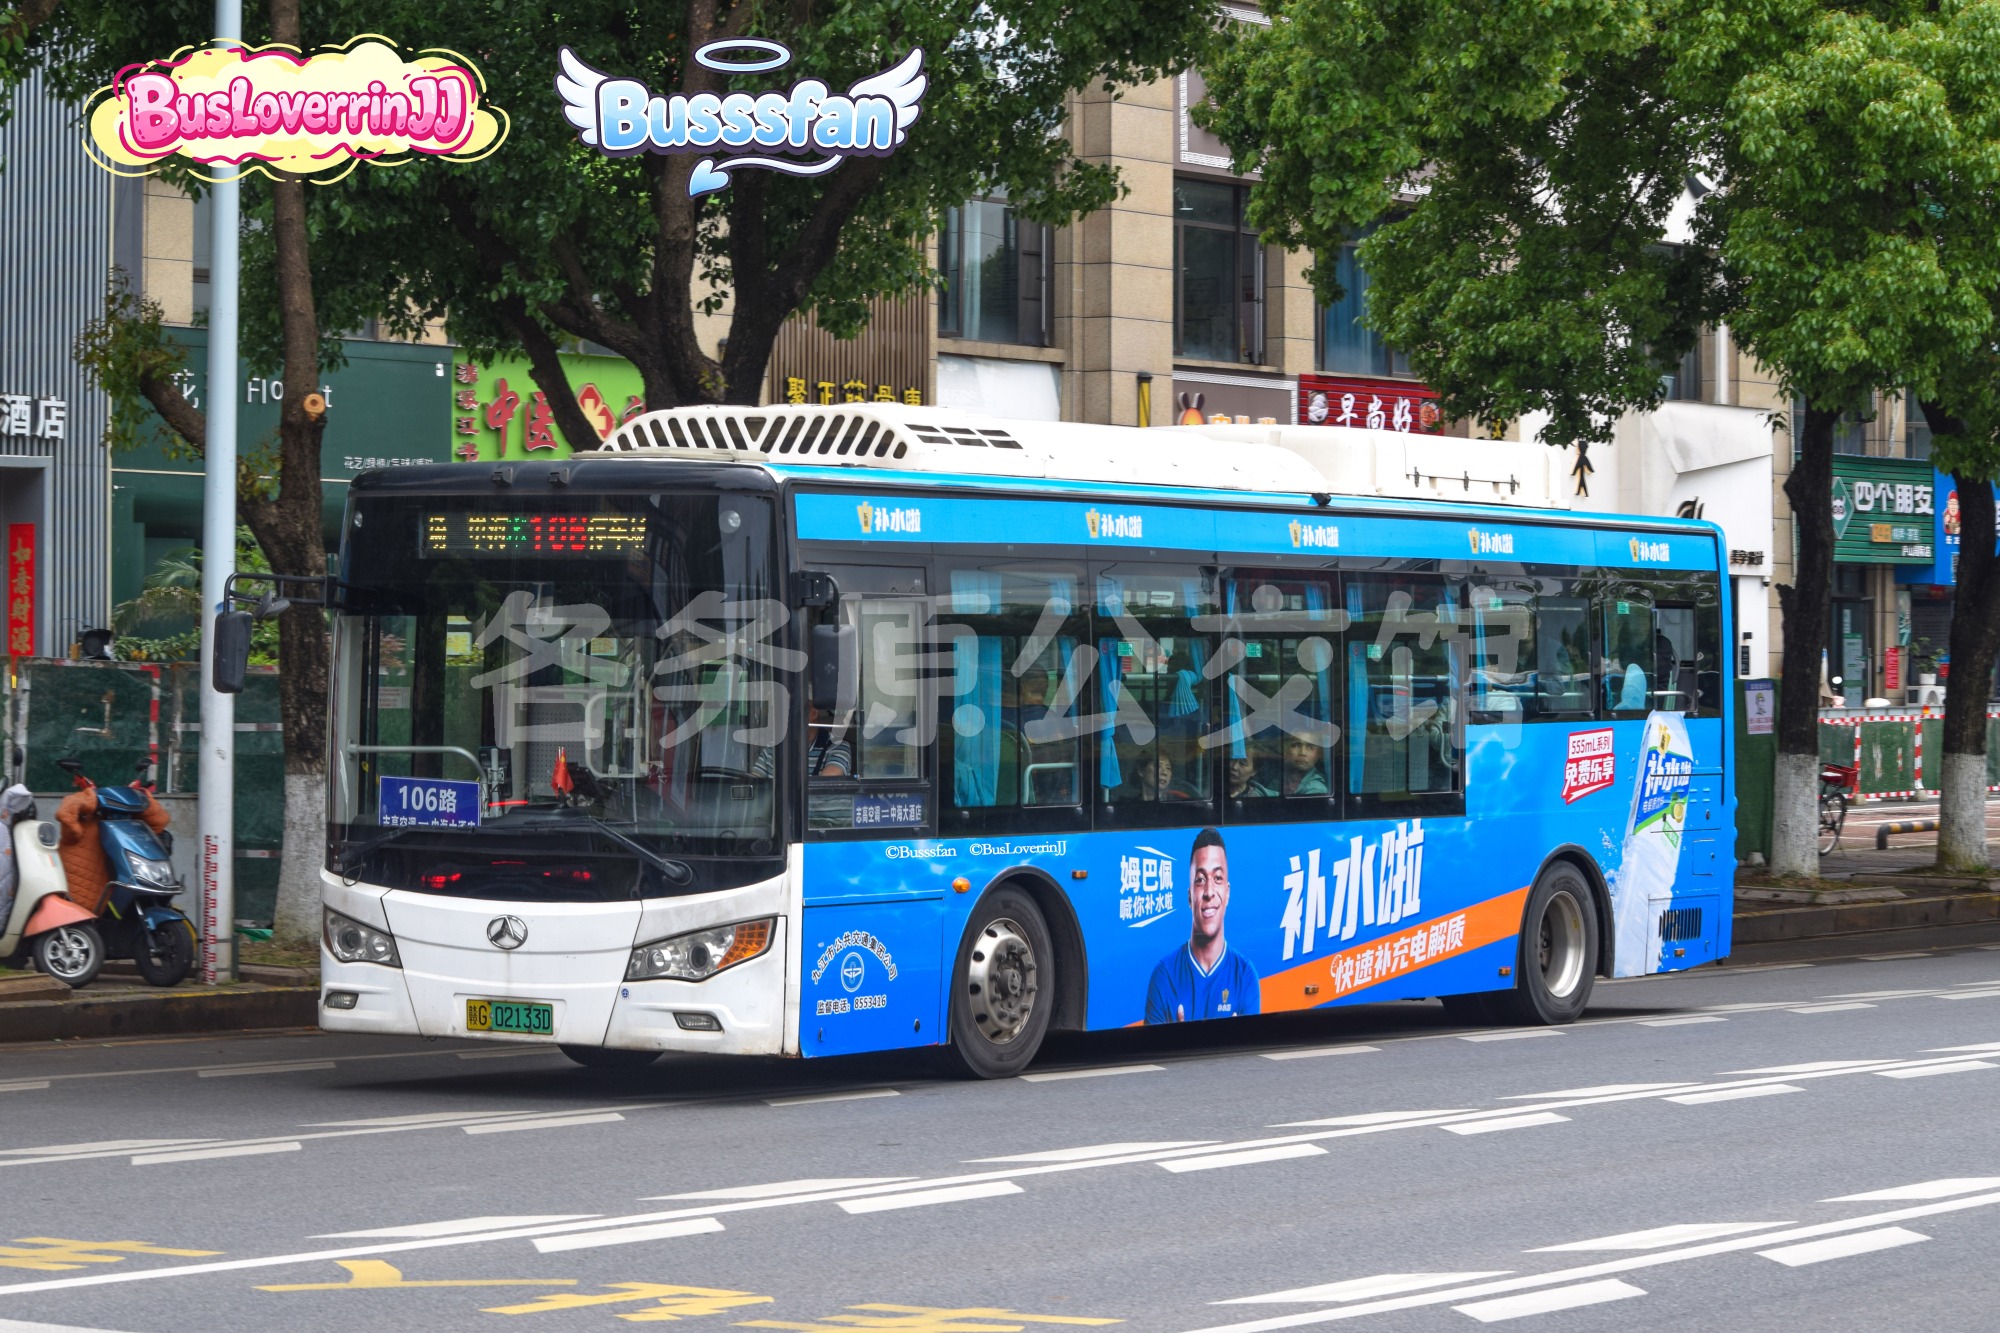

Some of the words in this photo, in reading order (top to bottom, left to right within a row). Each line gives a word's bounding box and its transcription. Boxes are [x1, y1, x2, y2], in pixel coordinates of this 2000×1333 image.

[1854, 481, 1934, 515] 四个朋友
[874, 507, 921, 533] 补水啦
[1101, 513, 1143, 539] 补水啦
[1302, 524, 1339, 548] 补水啦
[1481, 531, 1514, 554] 补水啦
[1640, 541, 1671, 563] 补水啦
[1562, 756, 1615, 796] 免费乐享
[1644, 753, 1692, 798] 补水啦
[399, 785, 457, 814] 106路
[1119, 855, 1174, 895] 姆巴佩
[1280, 818, 1425, 961] 补水啦
[1119, 892, 1174, 921] 喊你补水啦
[811, 929, 898, 985] 九江市公共交通集团公司
[1335, 913, 1466, 994] 快速补充电解质
[853, 994, 887, 1011] 8553416
